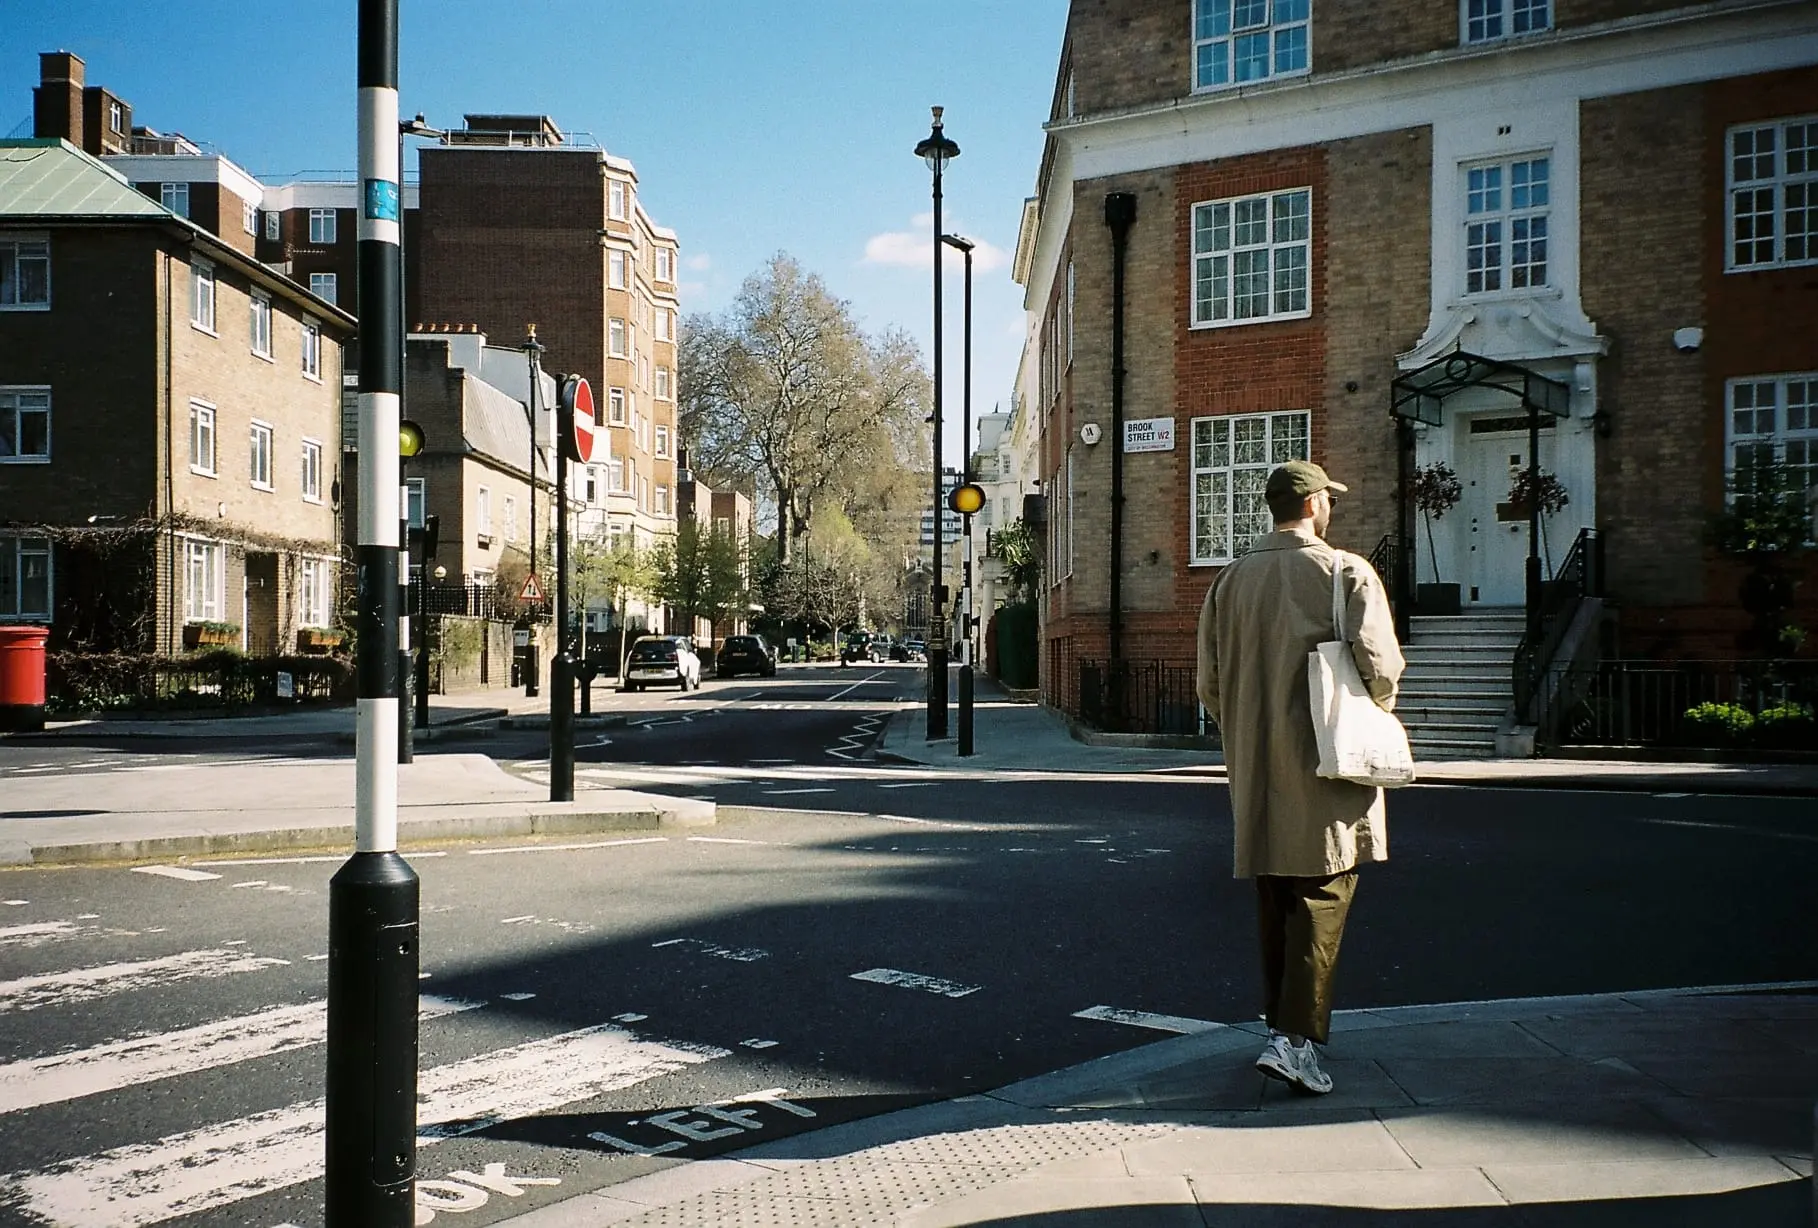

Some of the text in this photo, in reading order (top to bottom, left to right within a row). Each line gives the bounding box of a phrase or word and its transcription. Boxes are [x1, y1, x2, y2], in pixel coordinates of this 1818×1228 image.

[1127, 422, 1153, 432] BROOK
[1127, 430, 1170, 442] STREET W2
[587, 1087, 816, 1157] LEFT
[413, 1162, 562, 1226] OK
